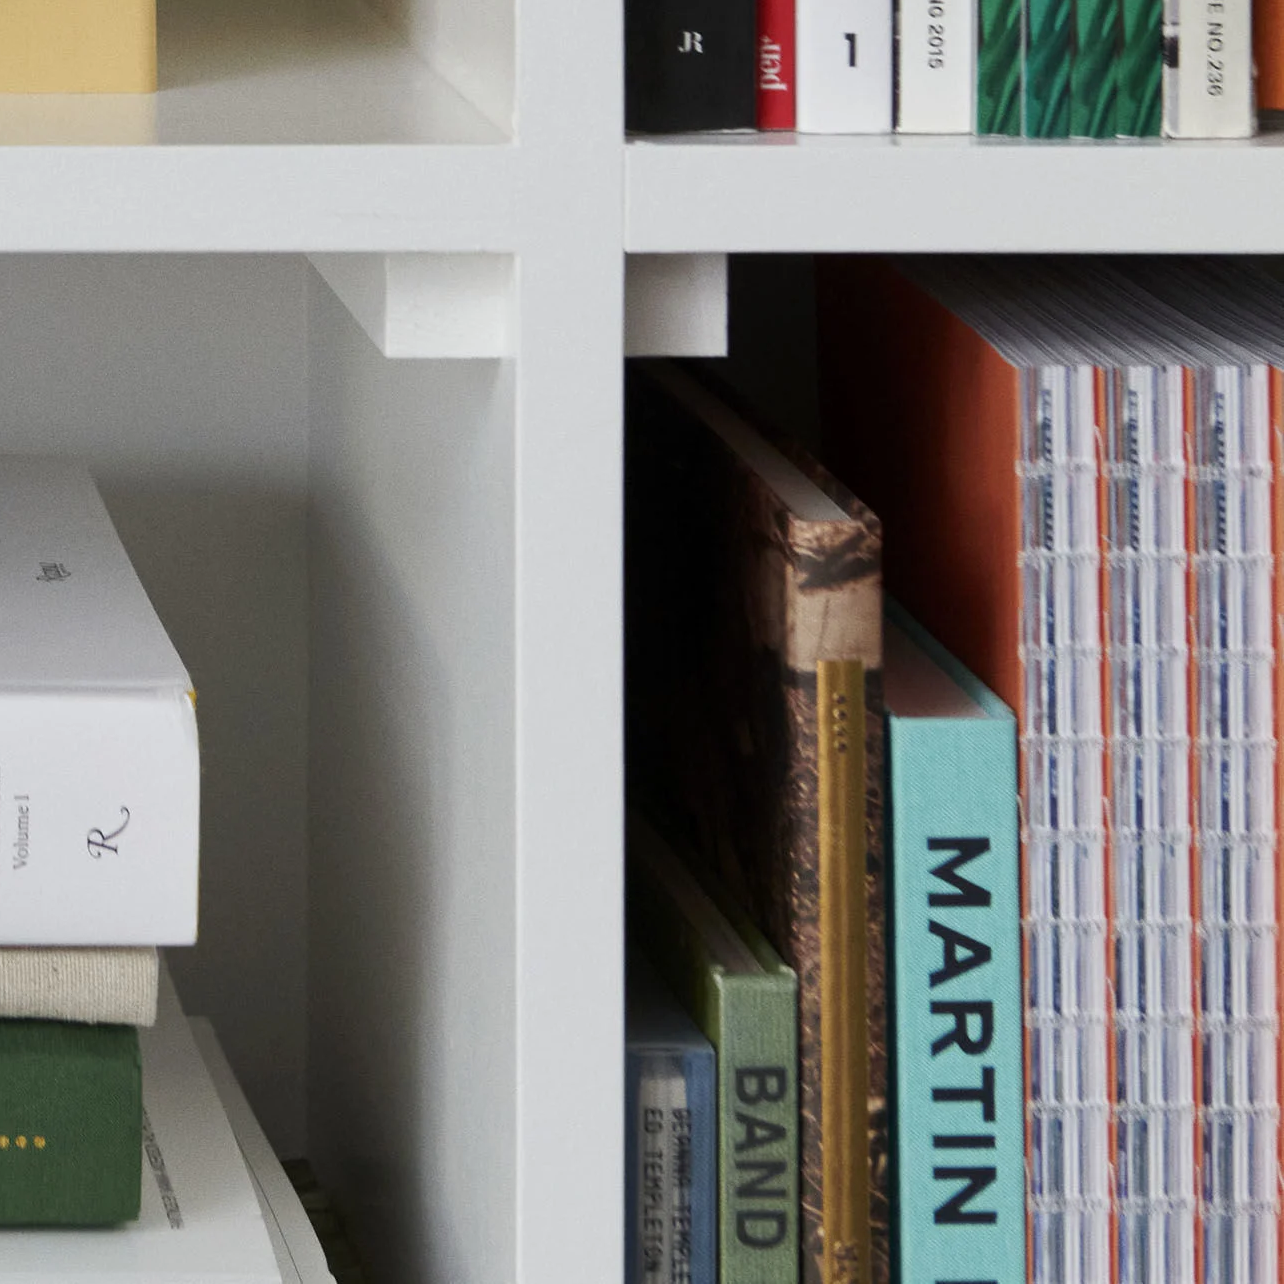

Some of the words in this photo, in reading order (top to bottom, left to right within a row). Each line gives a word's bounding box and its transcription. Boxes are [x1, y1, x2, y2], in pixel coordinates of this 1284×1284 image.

[929, 23, 944, 69] 2015
[926, 836, 998, 1225] MARTIN
[734, 1066, 790, 1249] BAND
